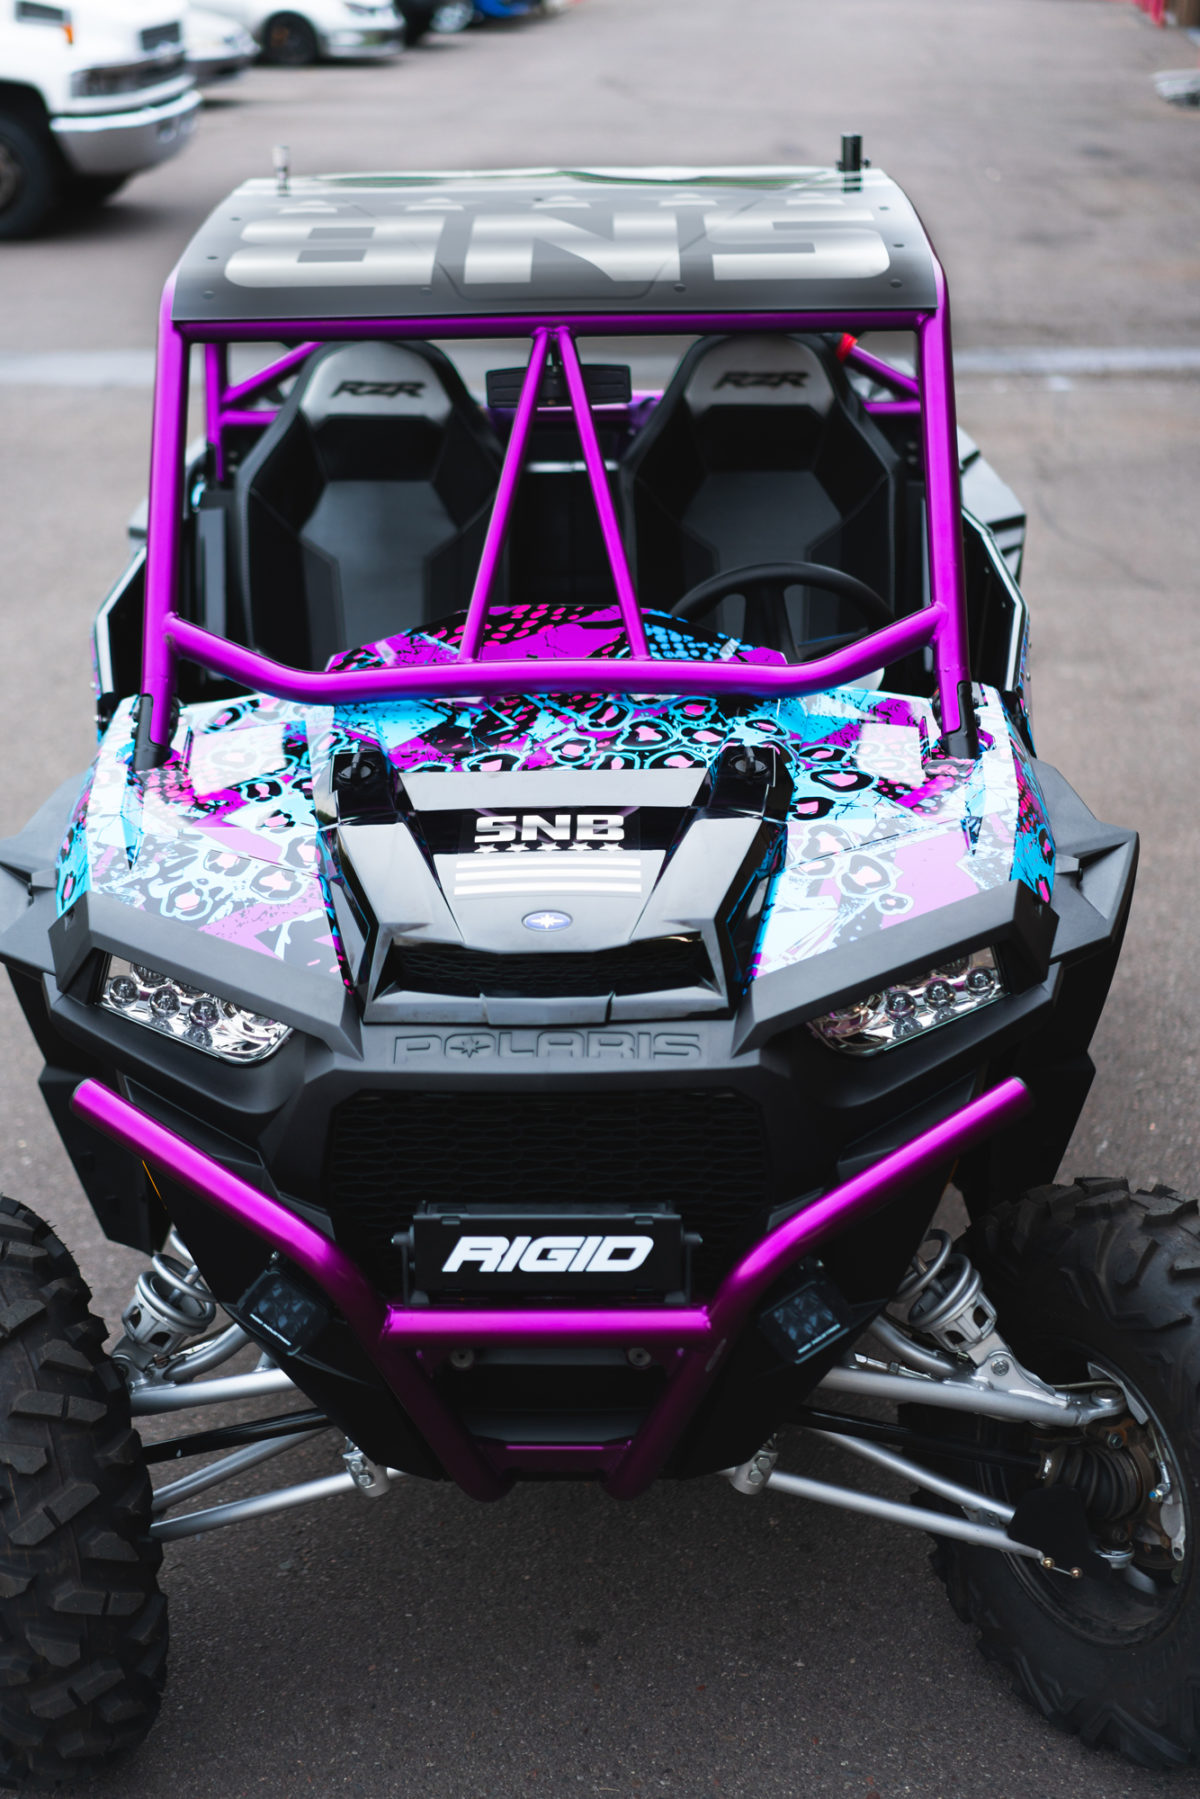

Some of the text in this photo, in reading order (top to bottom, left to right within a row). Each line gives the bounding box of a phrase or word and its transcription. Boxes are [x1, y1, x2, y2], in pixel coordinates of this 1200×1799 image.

[329, 380, 425, 398] RZR
[711, 371, 811, 391] RZR
[474, 814, 625, 843] SNB
[393, 1030, 702, 1064] POLARIS
[441, 1235, 654, 1272] RIGID
